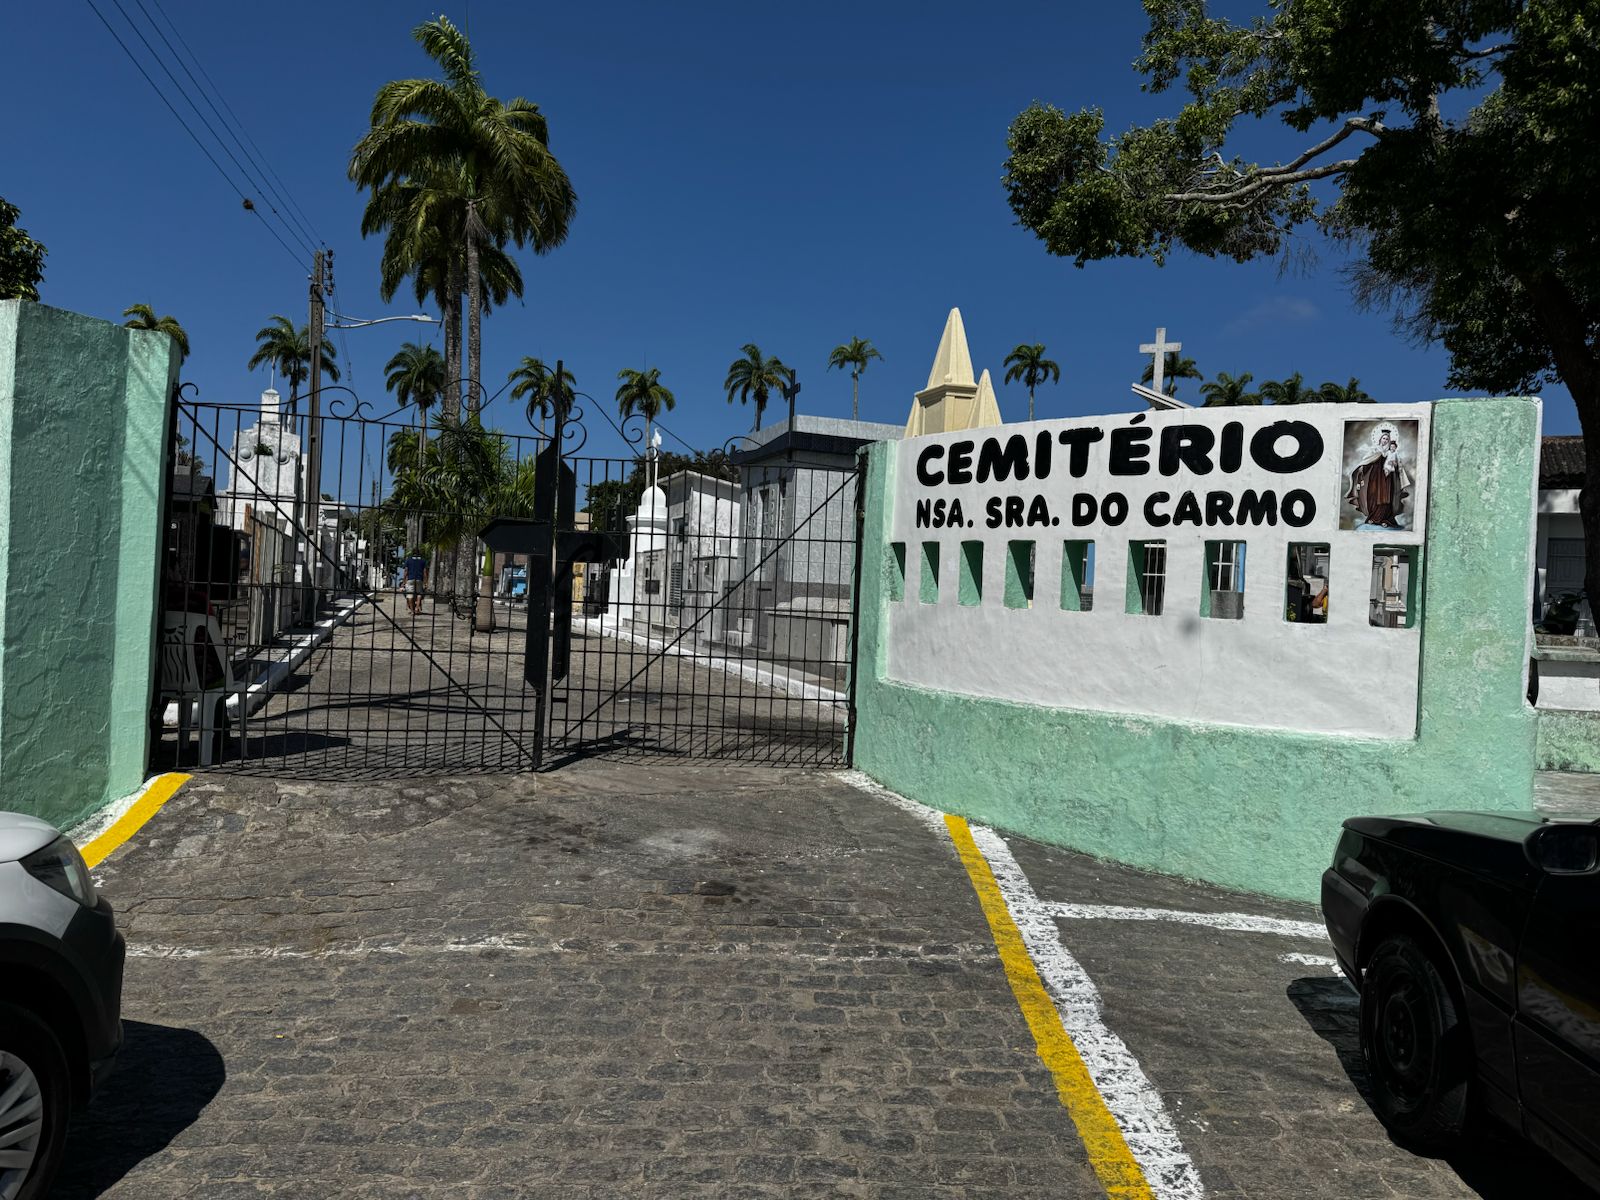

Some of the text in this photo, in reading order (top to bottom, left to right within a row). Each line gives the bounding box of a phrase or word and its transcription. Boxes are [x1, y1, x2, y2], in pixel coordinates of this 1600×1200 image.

[916, 413, 1325, 487] CEMITÉRIO
[916, 488, 1317, 529] NSA. SRA. DO CARMO
